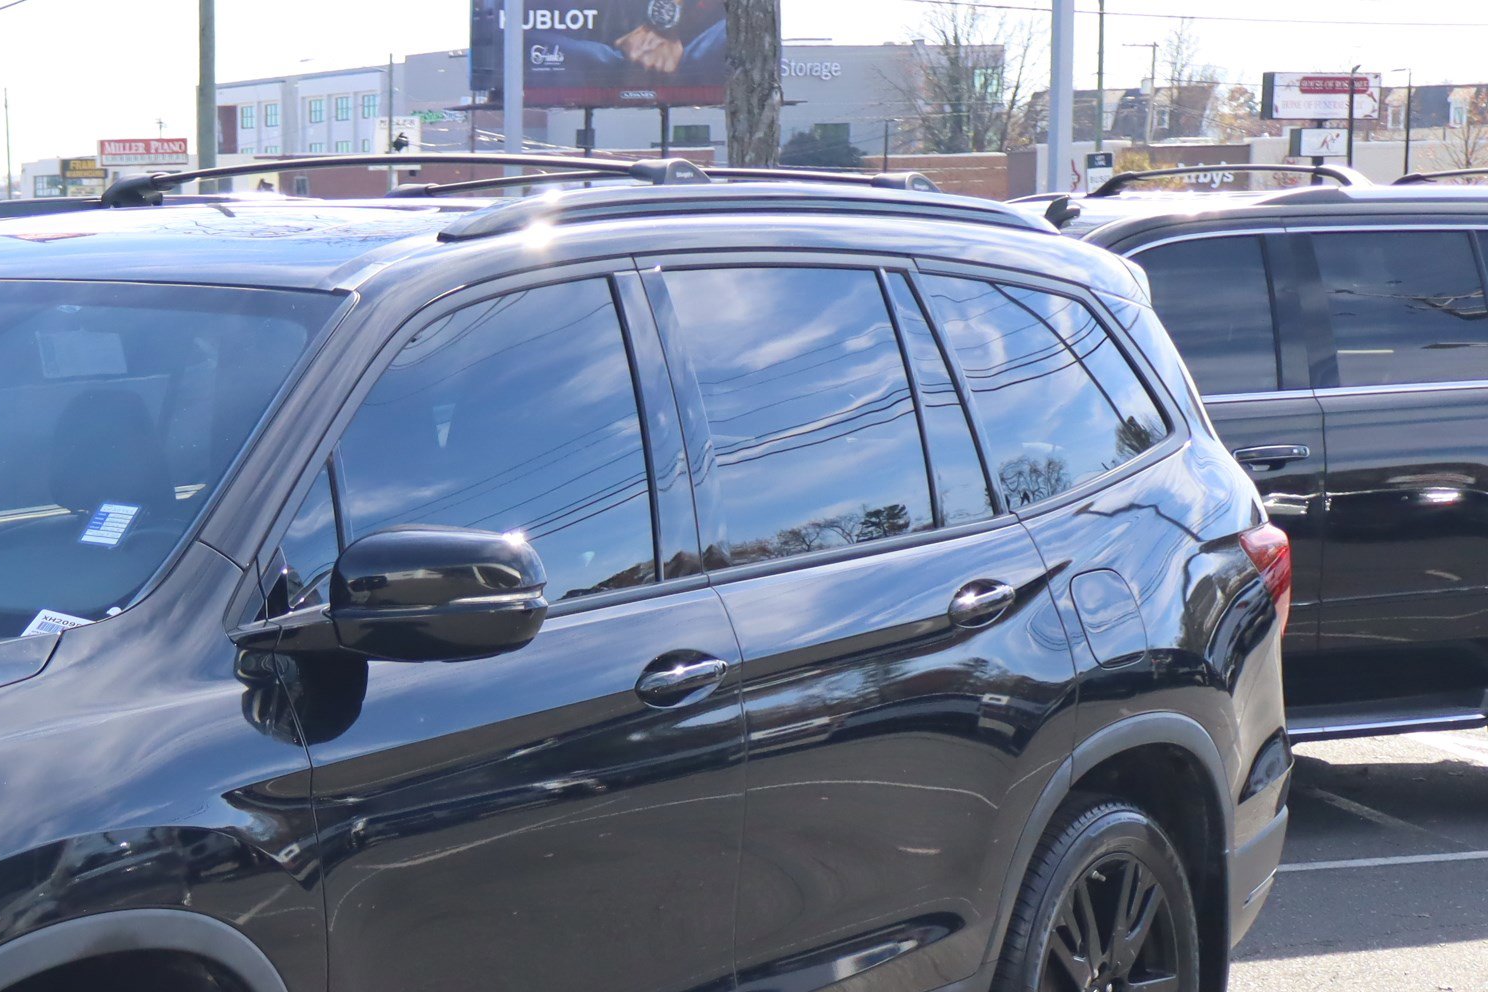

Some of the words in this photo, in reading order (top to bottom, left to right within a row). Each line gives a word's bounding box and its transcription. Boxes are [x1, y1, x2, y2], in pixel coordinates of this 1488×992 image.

[780, 58, 842, 81] Storage
[104, 141, 146, 154] MILLER
[150, 139, 186, 153] PIANO
